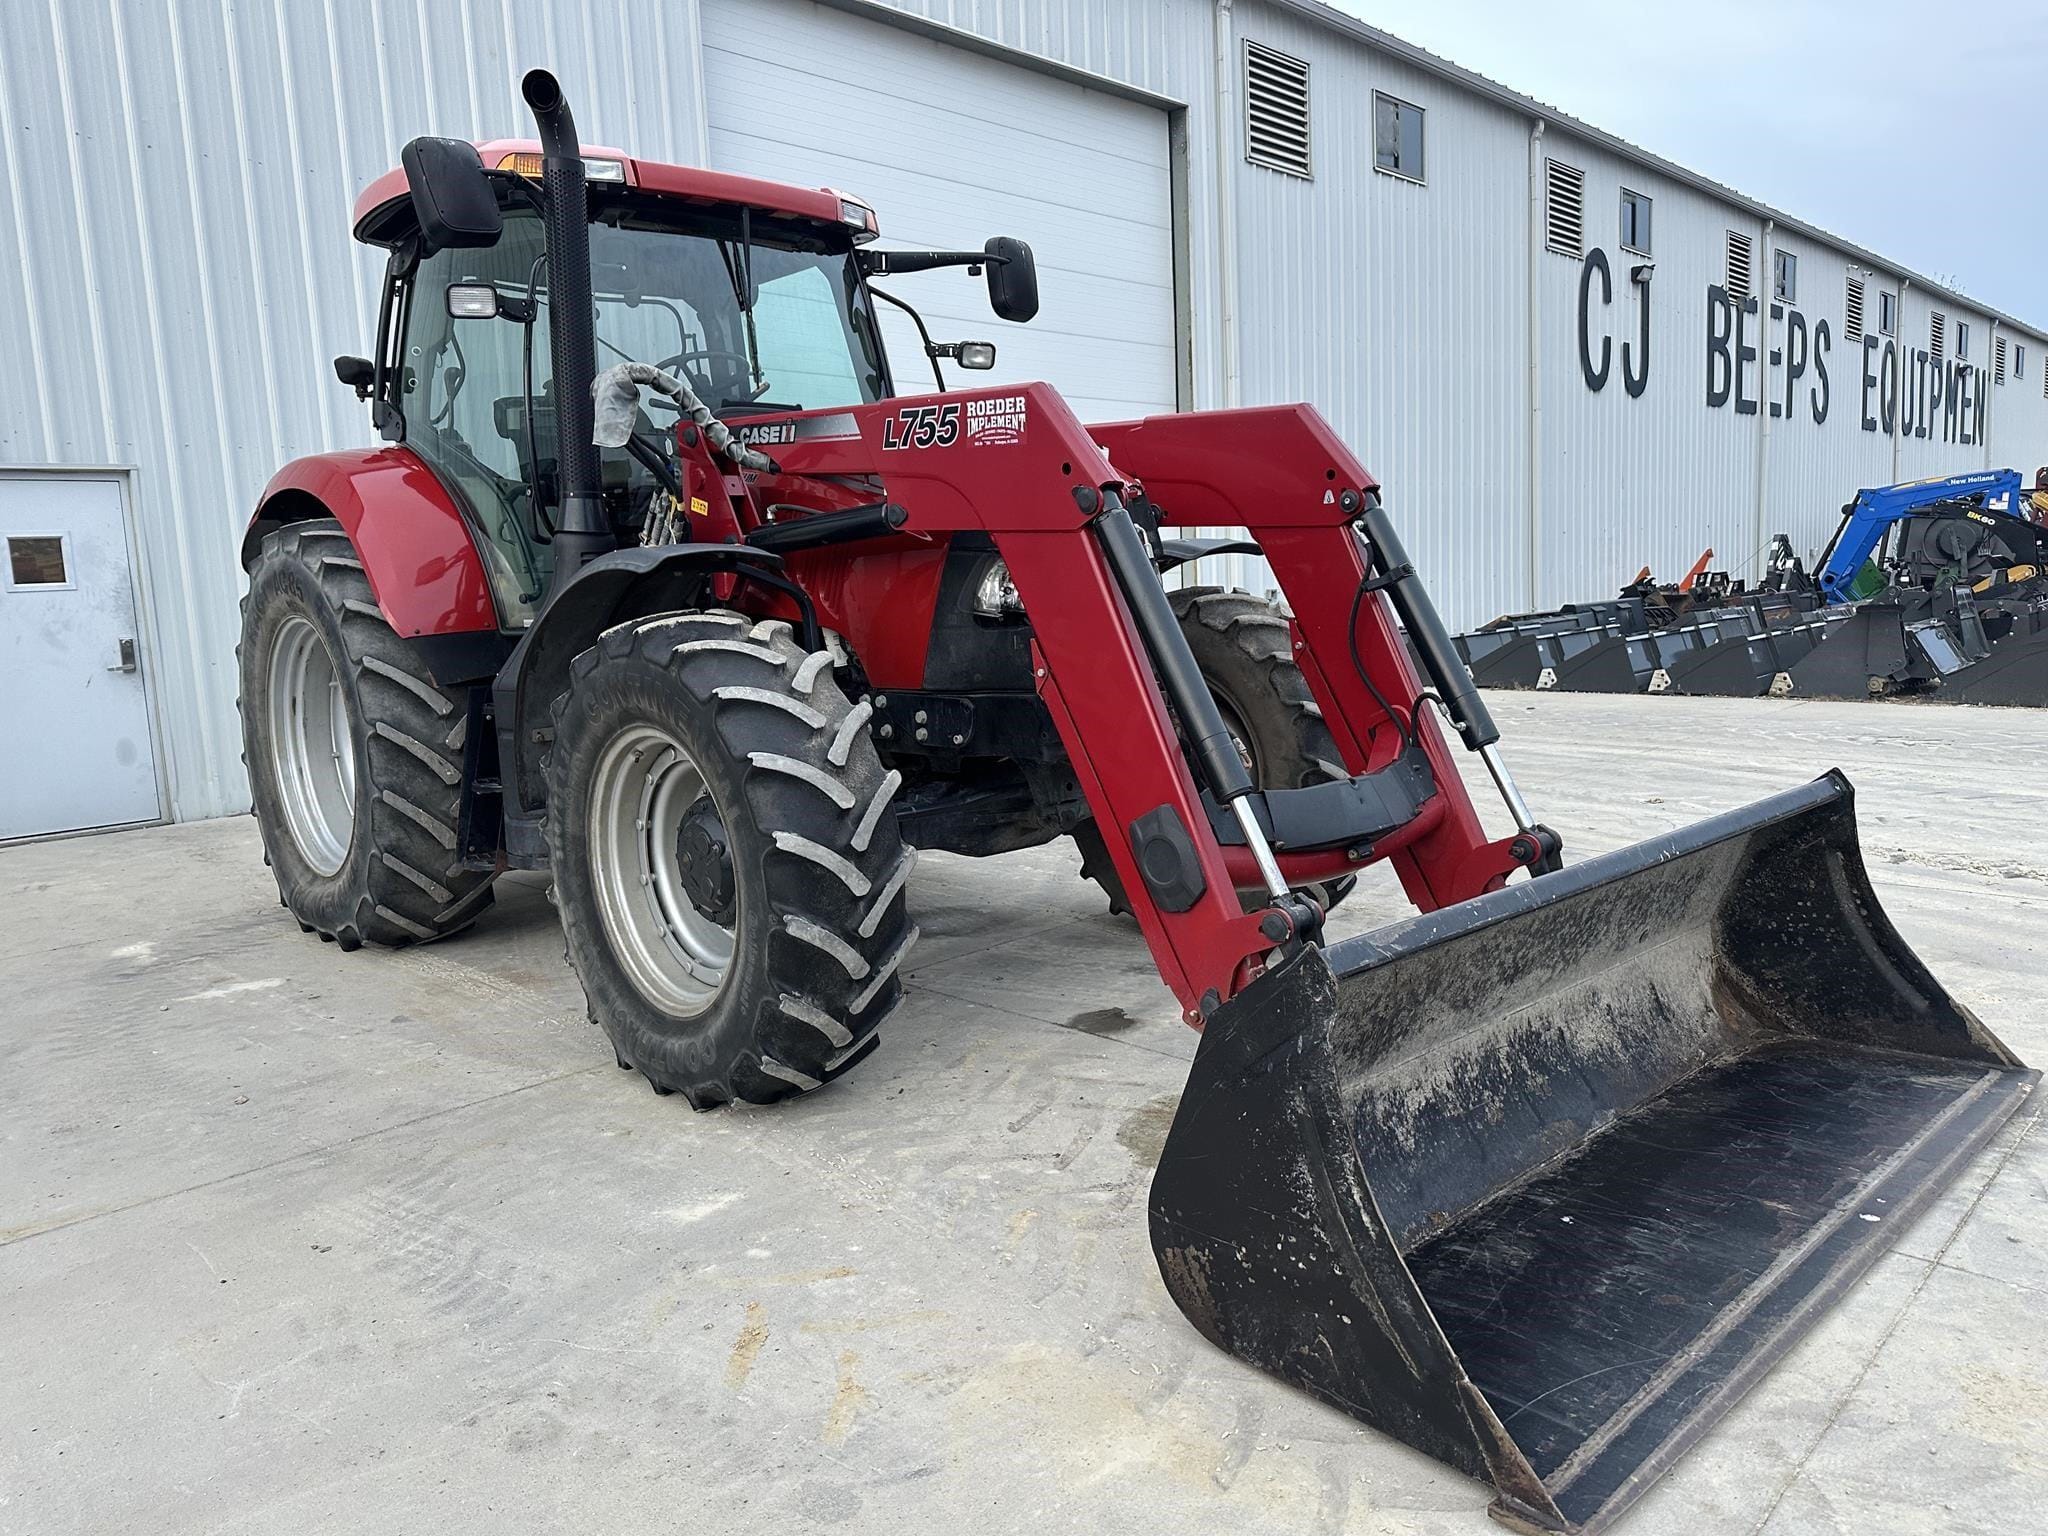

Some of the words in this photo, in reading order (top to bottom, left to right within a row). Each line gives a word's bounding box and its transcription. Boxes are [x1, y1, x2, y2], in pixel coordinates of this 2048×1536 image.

[1579, 247, 1650, 398] CJ
[1707, 283, 1831, 424] BEEPS
[1862, 334, 1991, 447] EQUIPMEN
[966, 396, 1026, 417] ROEDER
[740, 425, 780, 445] CASE
[883, 403, 961, 450] L755
[966, 413, 1026, 438] IMPLEMENT
[1967, 475, 1995, 484] Holland
